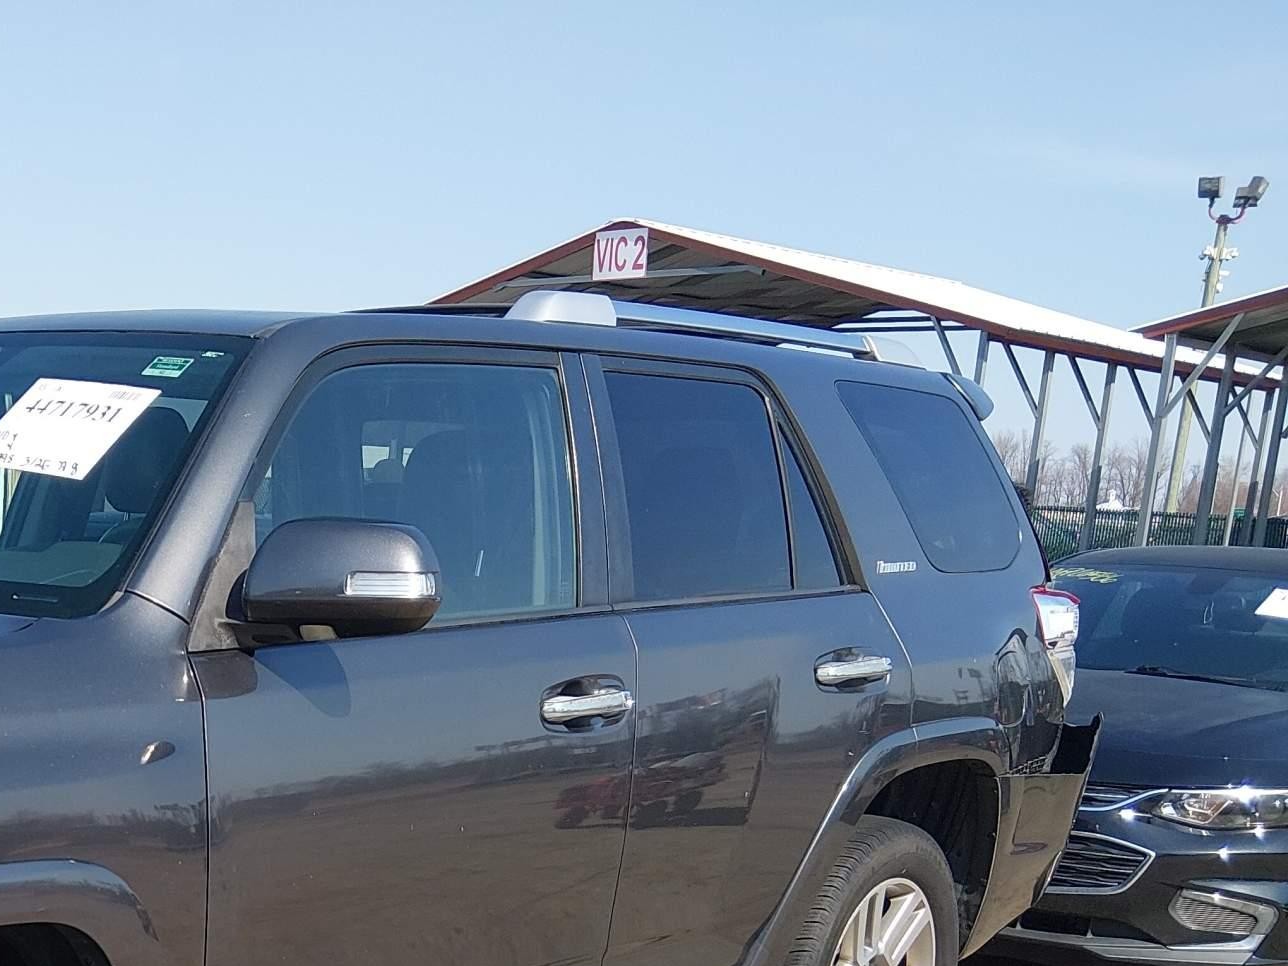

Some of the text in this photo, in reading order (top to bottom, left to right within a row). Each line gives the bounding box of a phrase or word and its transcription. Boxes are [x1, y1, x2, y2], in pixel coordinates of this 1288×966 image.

[597, 235, 645, 273] VIC 2
[25, 399, 123, 423] 44717931
